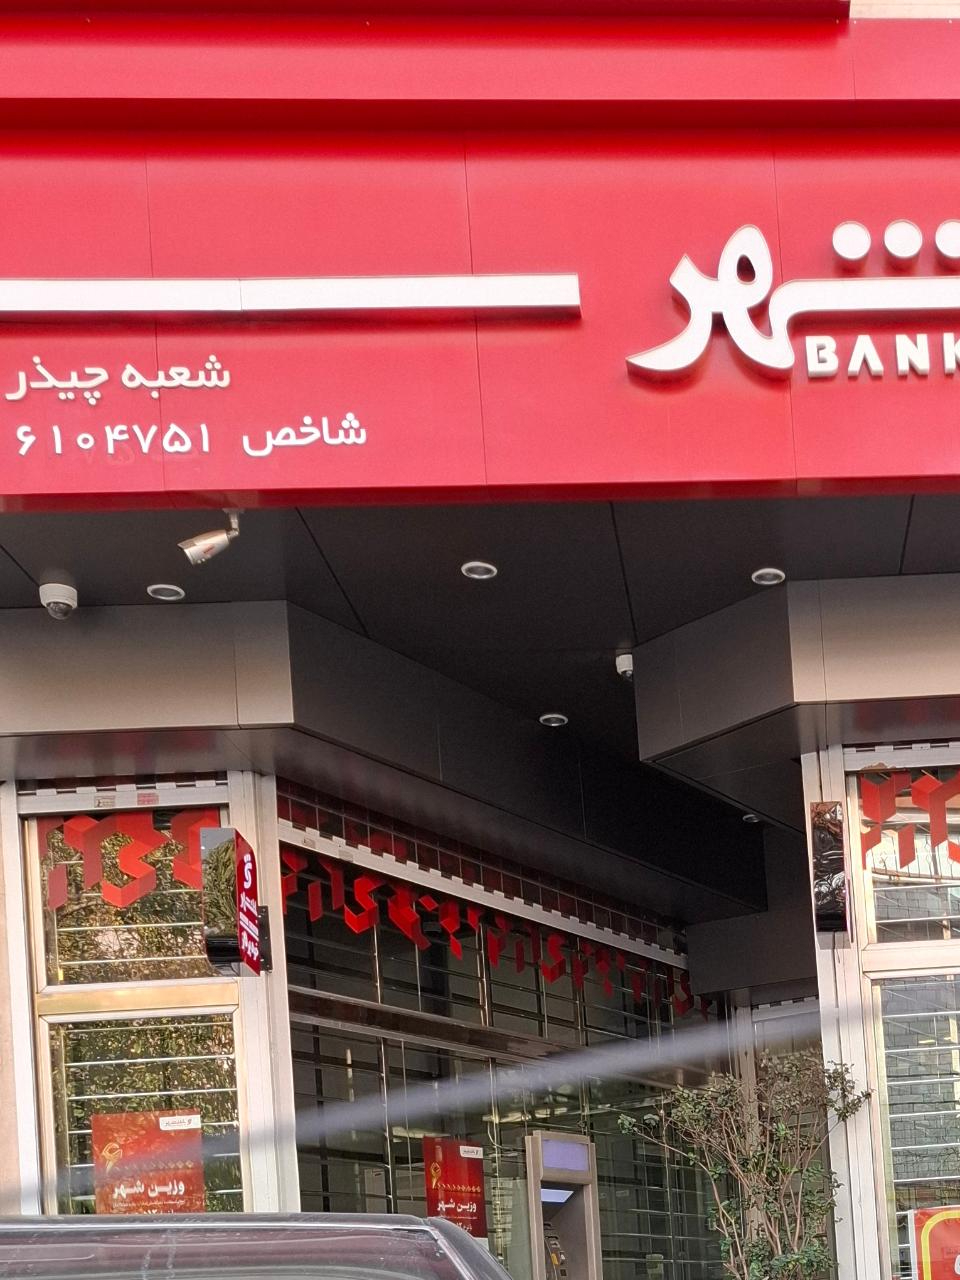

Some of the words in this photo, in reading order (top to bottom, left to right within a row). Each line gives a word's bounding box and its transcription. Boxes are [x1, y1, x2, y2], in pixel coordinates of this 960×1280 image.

[5, 355, 109, 406] چیذر
[121, 354, 232, 399] شعبه
[15, 422, 210, 456] ۶۱۰۴۷۵۱
[242, 412, 367, 457] شاخص
[112, 1179, 145, 1199] شهر
[437, 1198, 455, 1212] شهر
